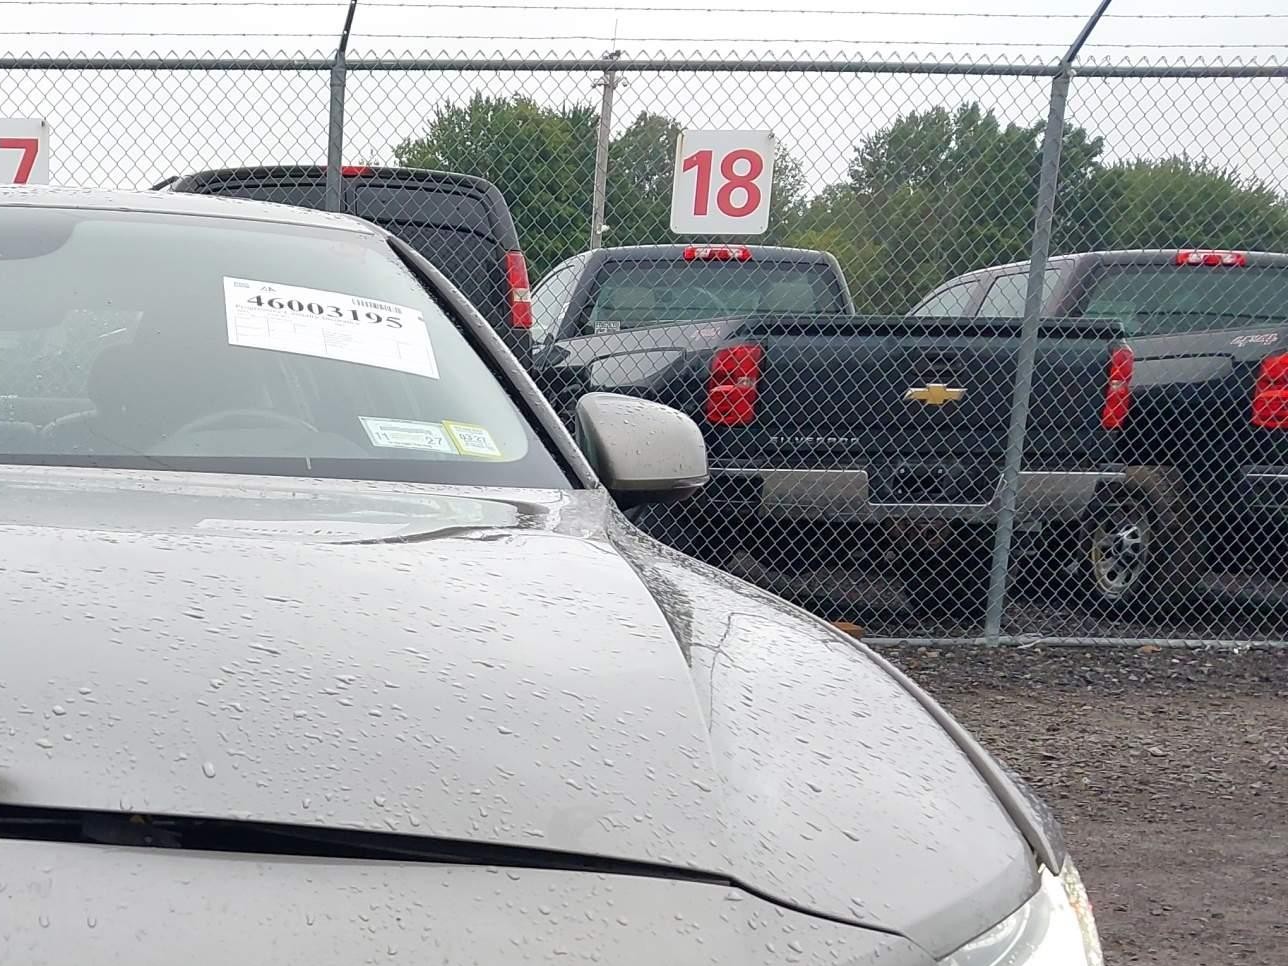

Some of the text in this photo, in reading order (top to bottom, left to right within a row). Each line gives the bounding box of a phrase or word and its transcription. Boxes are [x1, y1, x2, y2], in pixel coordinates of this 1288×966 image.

[682, 148, 764, 217] 18
[247, 294, 403, 329] 46003195
[423, 435, 443, 446] 27
